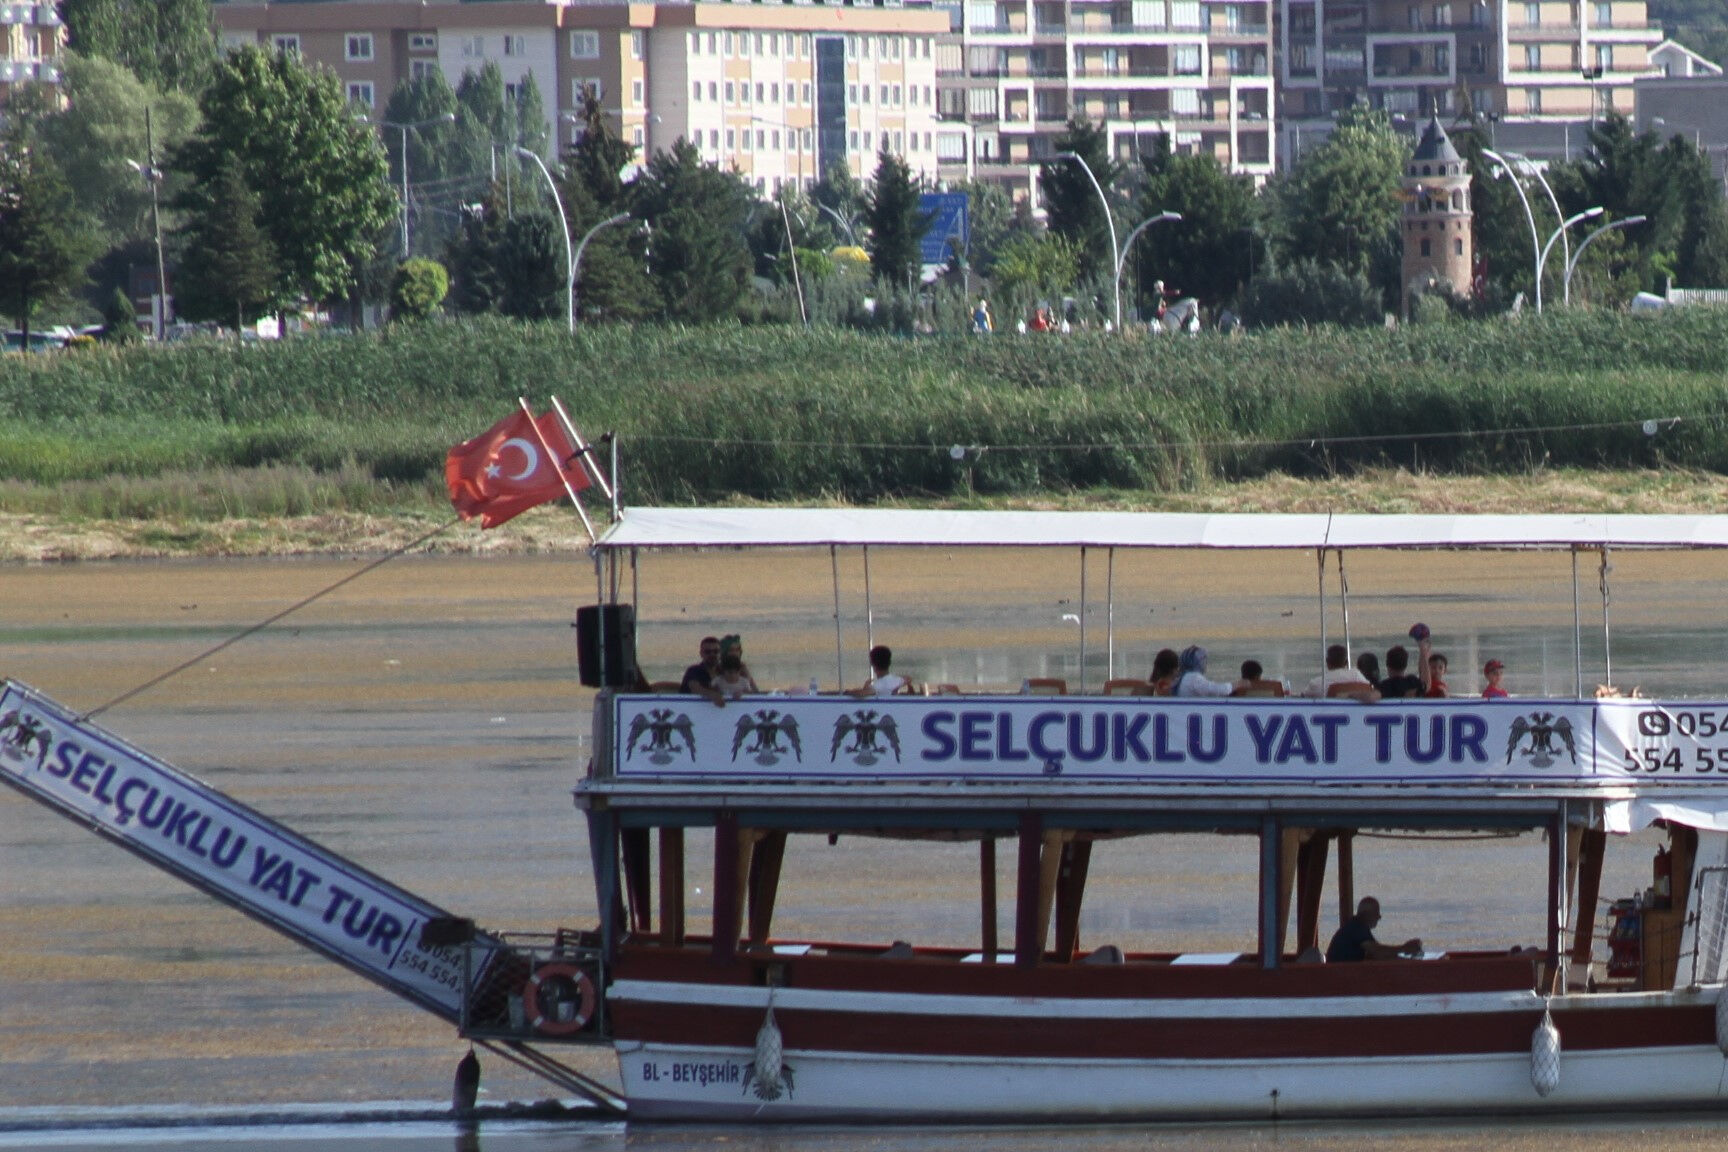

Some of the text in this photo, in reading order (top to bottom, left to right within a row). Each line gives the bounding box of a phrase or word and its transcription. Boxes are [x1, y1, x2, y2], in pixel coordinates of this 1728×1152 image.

[920, 710, 1489, 776] SELÇUKLU YAT TUR
[1624, 746, 1684, 773] 554
[47, 741, 403, 956] SELÇUKLU YAT TUR
[643, 1062, 660, 1081] BL
[672, 1060, 739, 1087] BEYŞEHİR
